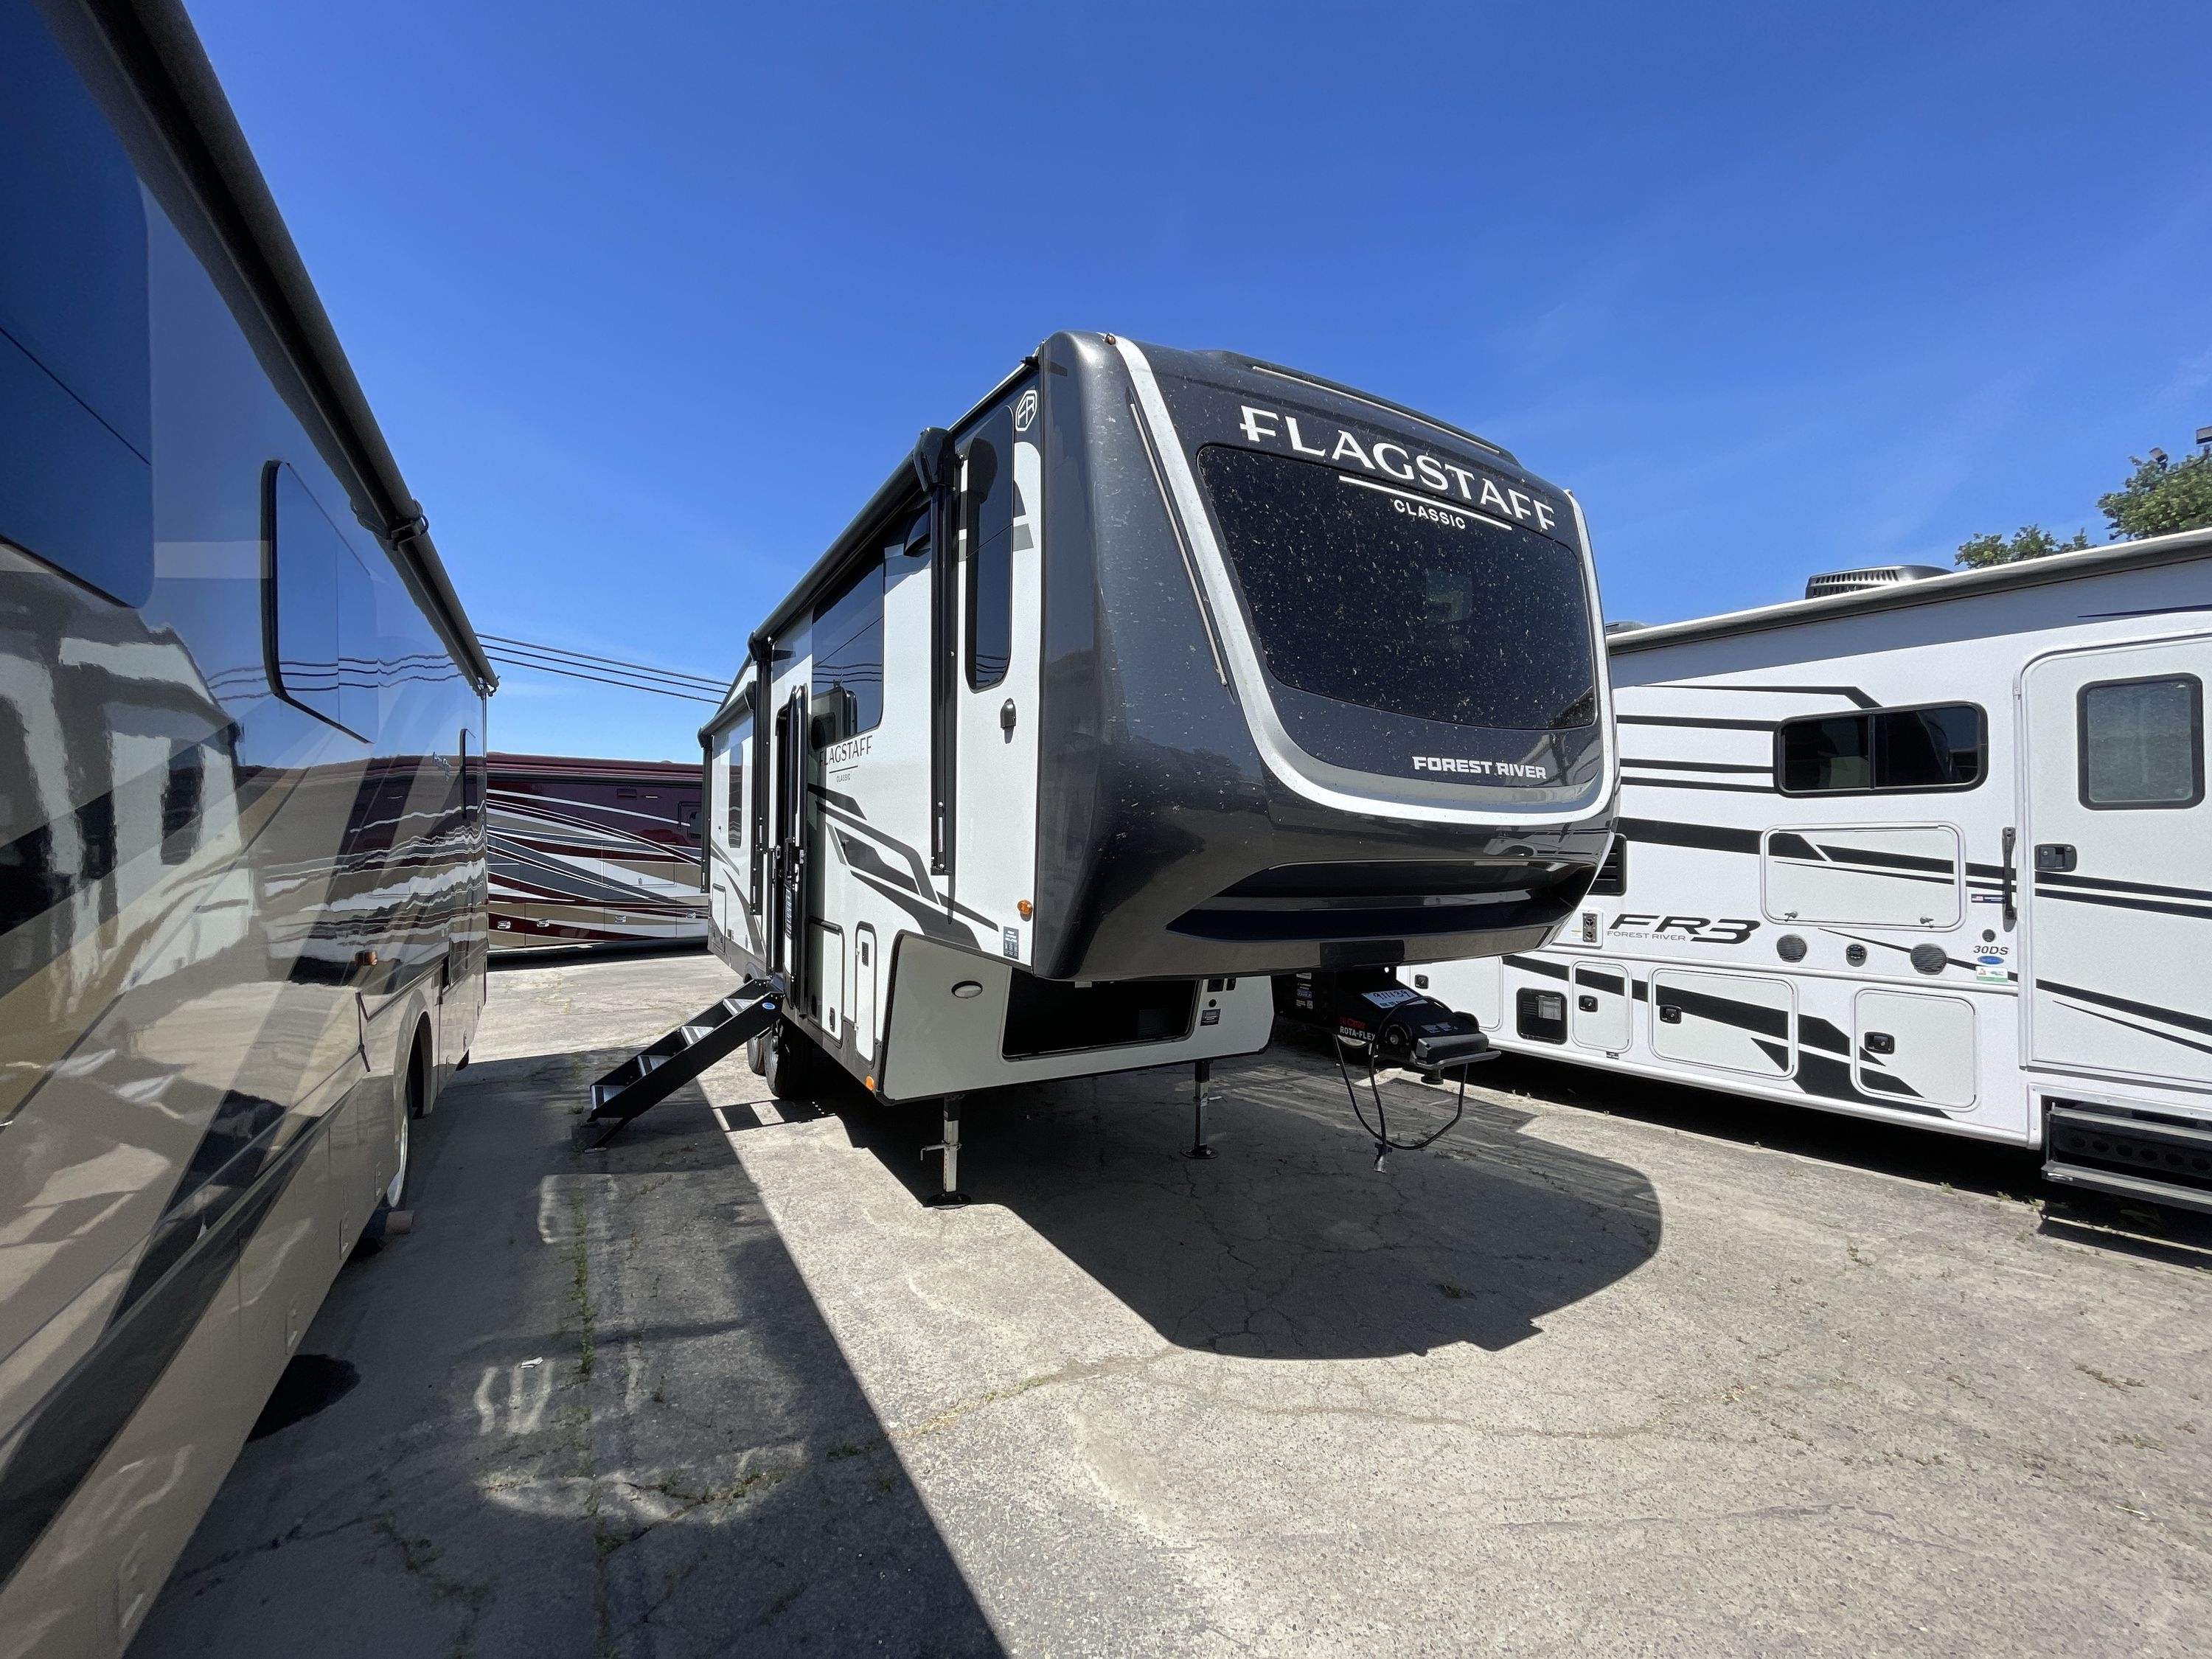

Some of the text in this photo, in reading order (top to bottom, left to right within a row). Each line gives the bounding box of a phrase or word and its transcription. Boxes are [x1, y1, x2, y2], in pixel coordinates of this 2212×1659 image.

[1239, 405, 1556, 530] FLAGSTAFF
[1394, 498, 1467, 529] CLASSIC
[819, 735, 873, 767] FLAGSTAFF
[836, 773, 851, 783] CLASSIC
[1412, 757, 1547, 779] FOREST RIVER
[1607, 931, 1686, 942] FOREST RIVER
[1609, 914, 1761, 945] FR3
[1973, 945, 2009, 956] 30DS
[1340, 1026, 1376, 1041] ROTA-FLEX
